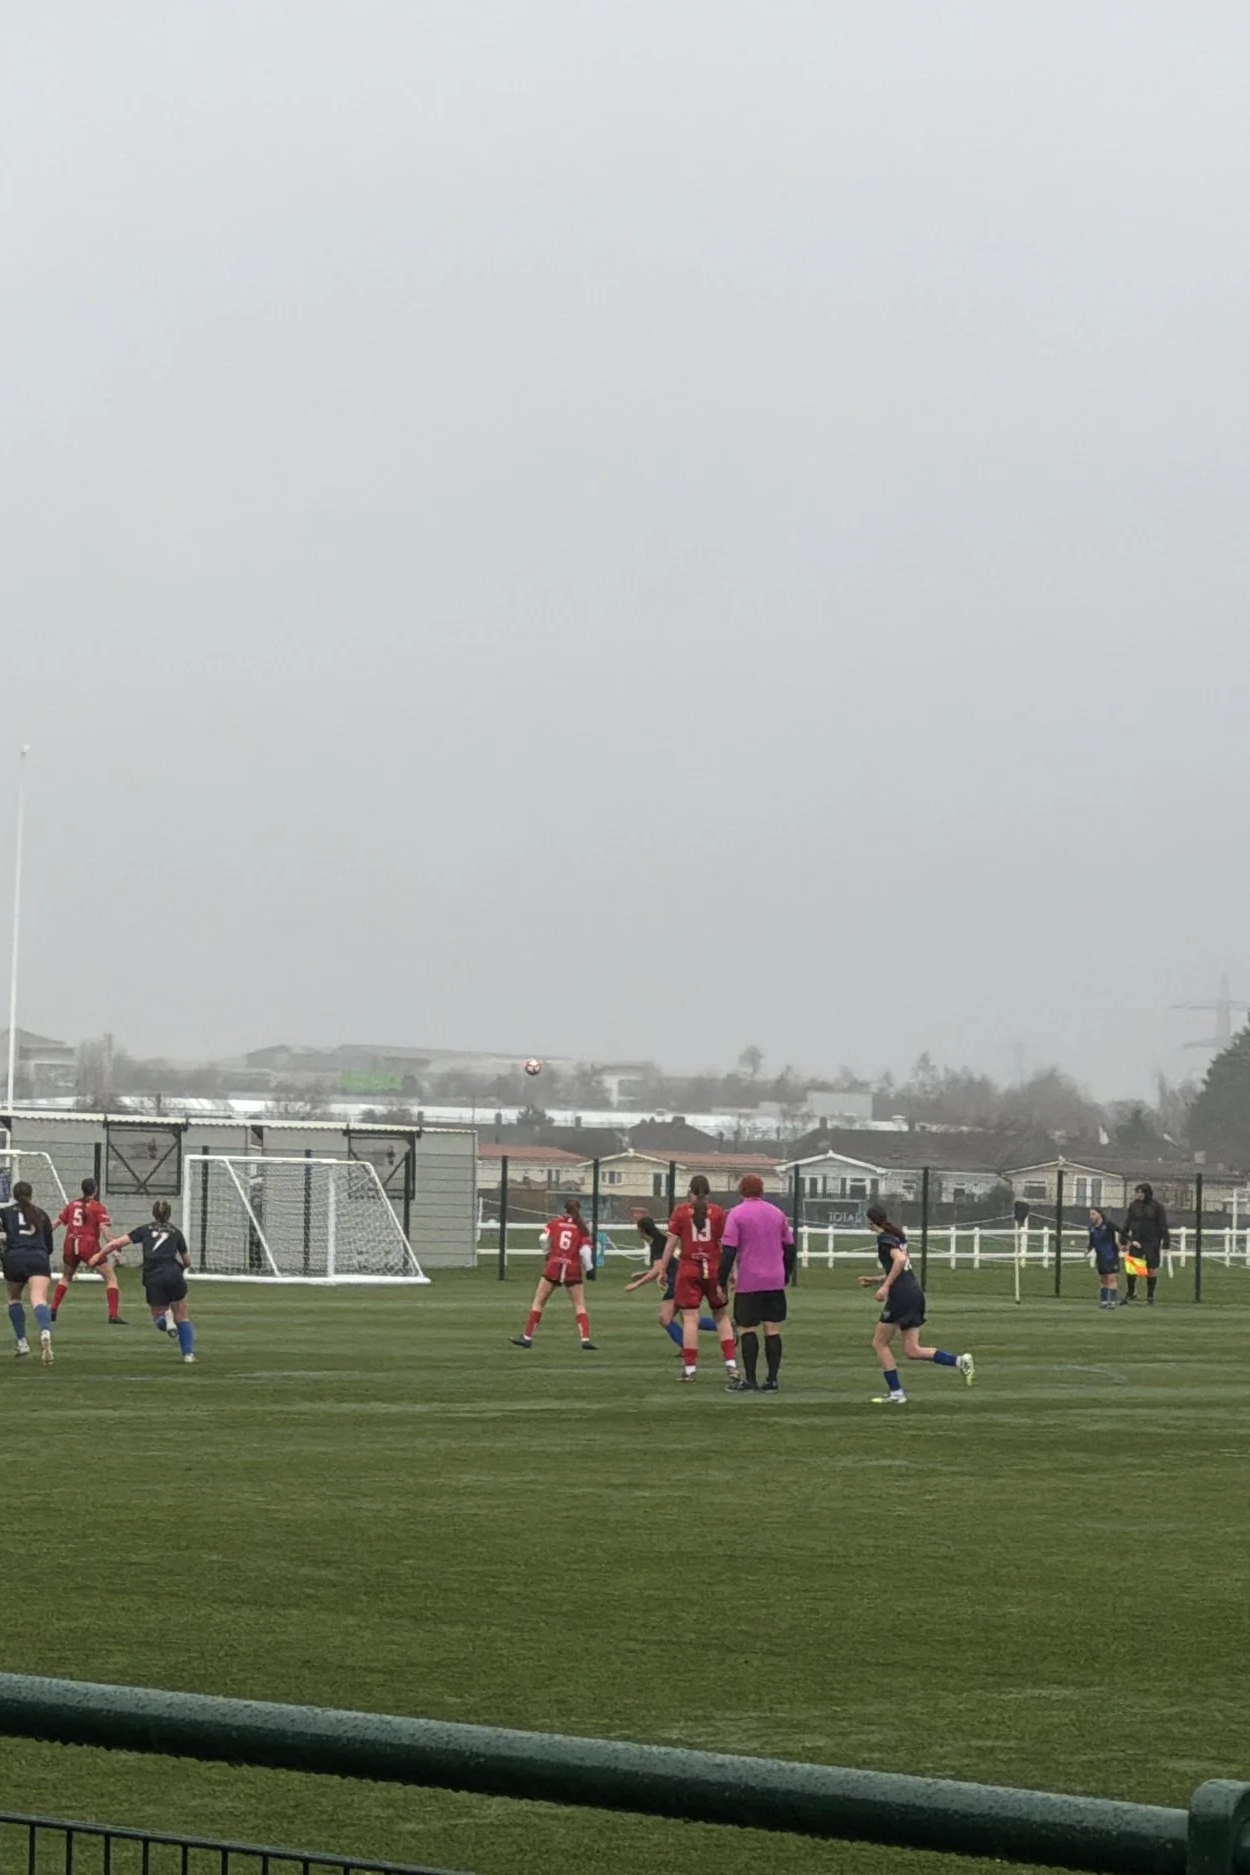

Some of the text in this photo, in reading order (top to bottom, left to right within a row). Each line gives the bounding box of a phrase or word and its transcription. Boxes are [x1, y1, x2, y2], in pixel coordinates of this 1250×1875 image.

[73, 1208, 83, 1226] 5
[151, 1230, 169, 1252] 7
[559, 1230, 573, 1250] 6
